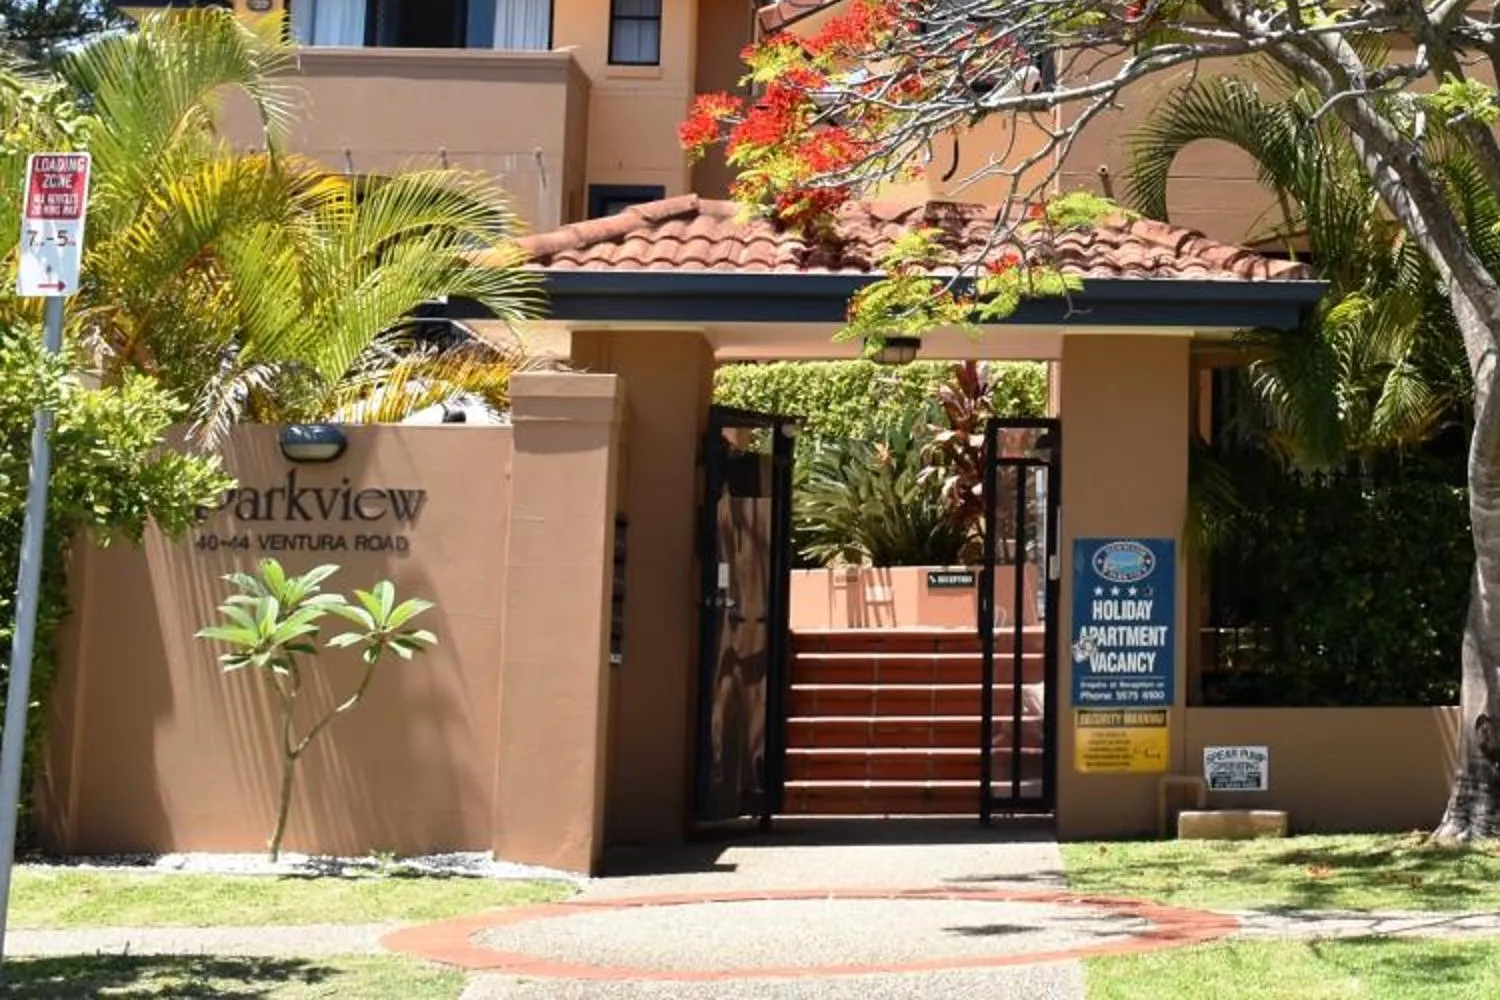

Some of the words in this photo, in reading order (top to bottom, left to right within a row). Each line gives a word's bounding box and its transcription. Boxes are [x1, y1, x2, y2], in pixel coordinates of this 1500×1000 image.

[35, 157, 85, 172] LOADING
[42, 173, 72, 189] ZONE
[258, 534, 347, 551] VENTURA
[355, 535, 410, 552] ROAD
[1092, 599, 1153, 621] HOLIDAY
[1080, 625, 1168, 647] APARTMENT
[1089, 651, 1157, 673] VACANCY
